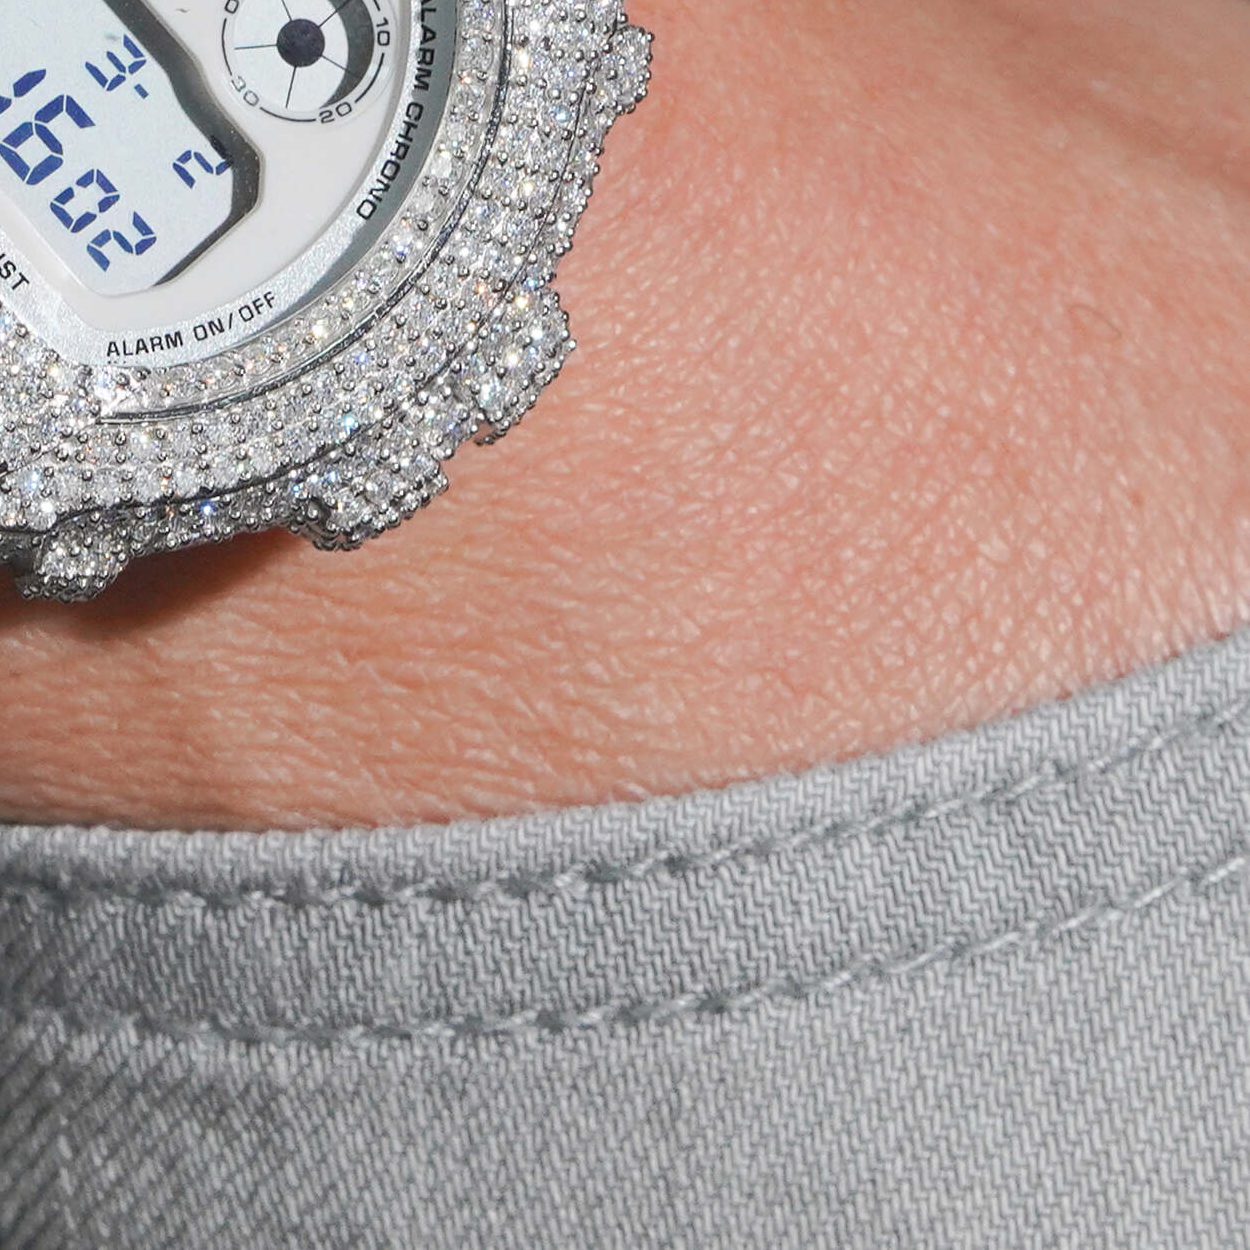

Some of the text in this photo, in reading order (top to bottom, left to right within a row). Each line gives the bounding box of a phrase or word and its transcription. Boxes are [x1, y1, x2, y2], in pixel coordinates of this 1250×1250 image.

[375, 16, 391, 47] 10
[229, 74, 261, 108] 30
[318, 101, 353, 125] 20
[355, 101, 424, 221] CHRONO
[105, 291, 276, 358] ALARM ON/OFF
